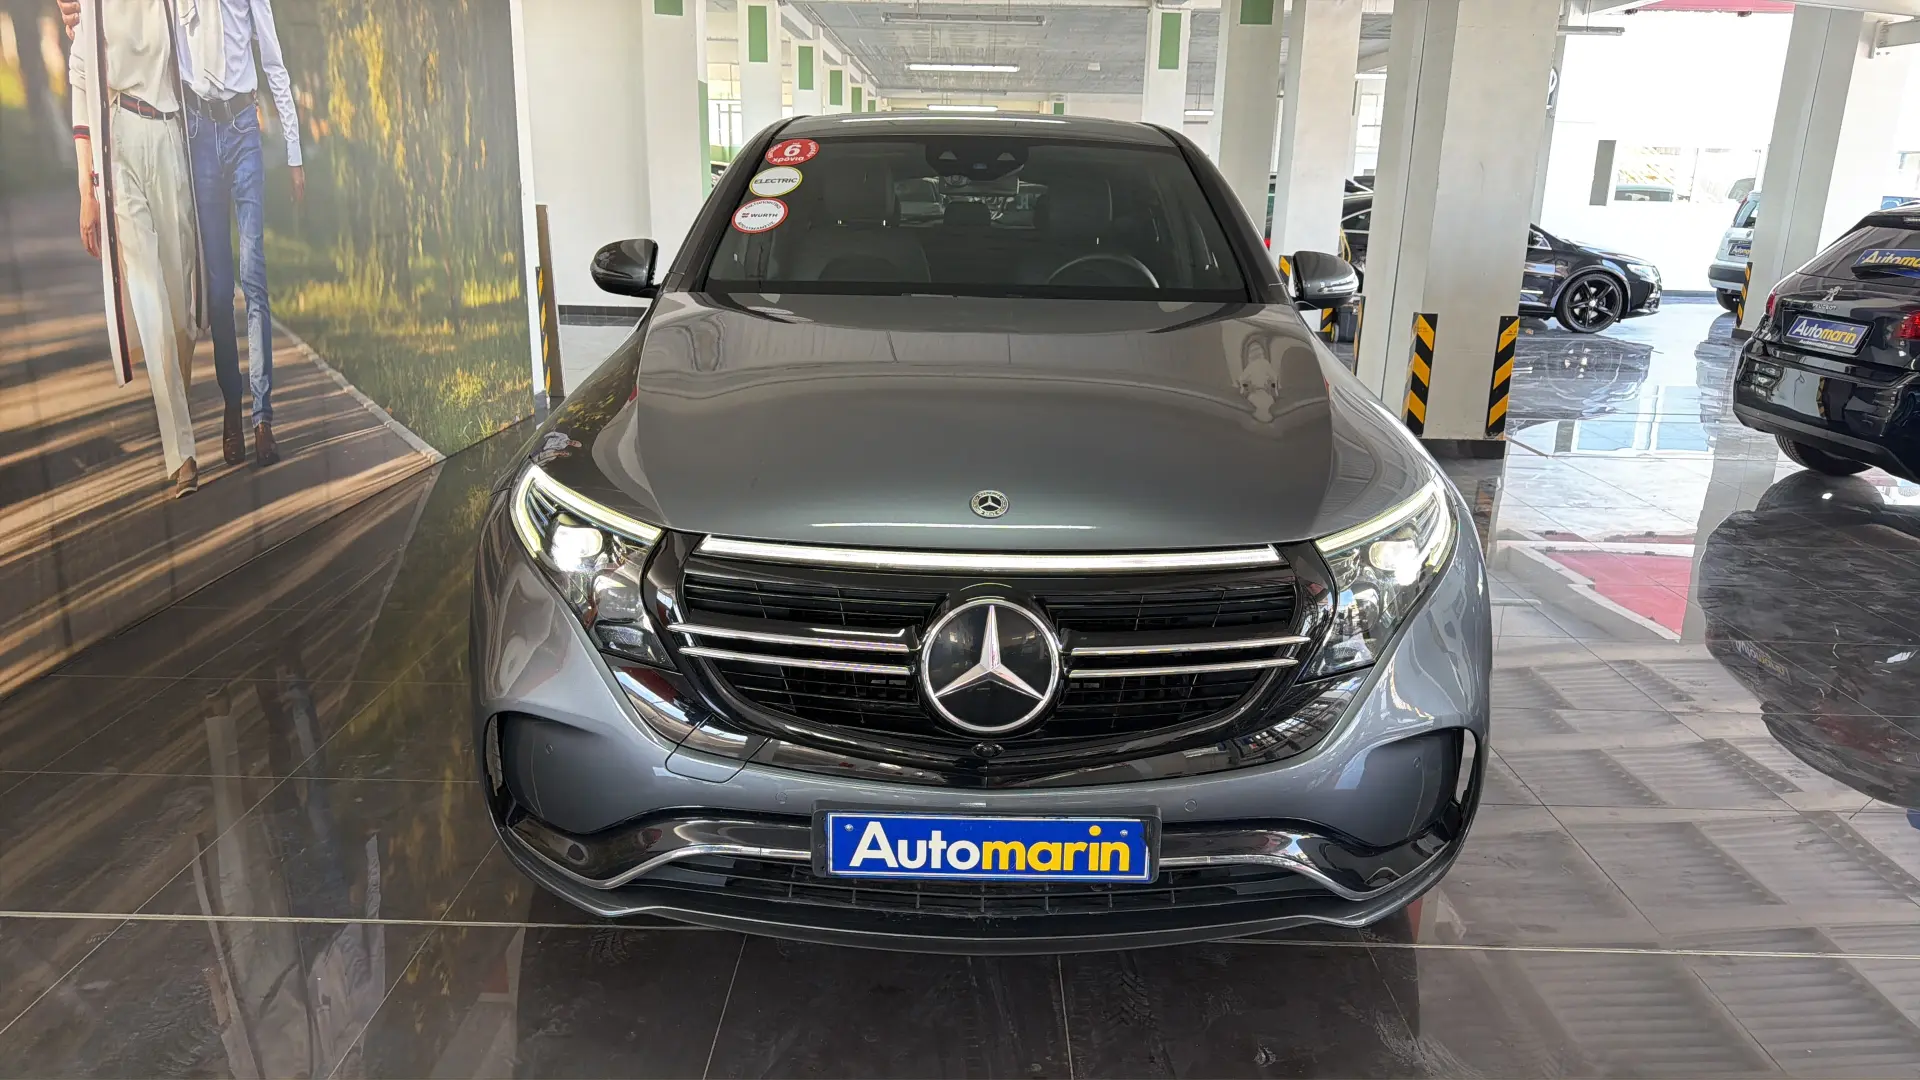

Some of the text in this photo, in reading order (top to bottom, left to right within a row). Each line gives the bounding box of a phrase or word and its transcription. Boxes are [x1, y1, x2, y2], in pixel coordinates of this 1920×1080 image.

[783, 144, 802, 157] 6
[754, 177, 798, 185] ELECTRIC
[1792, 319, 1857, 345] Automarin
[849, 821, 1131, 872] Automarin
